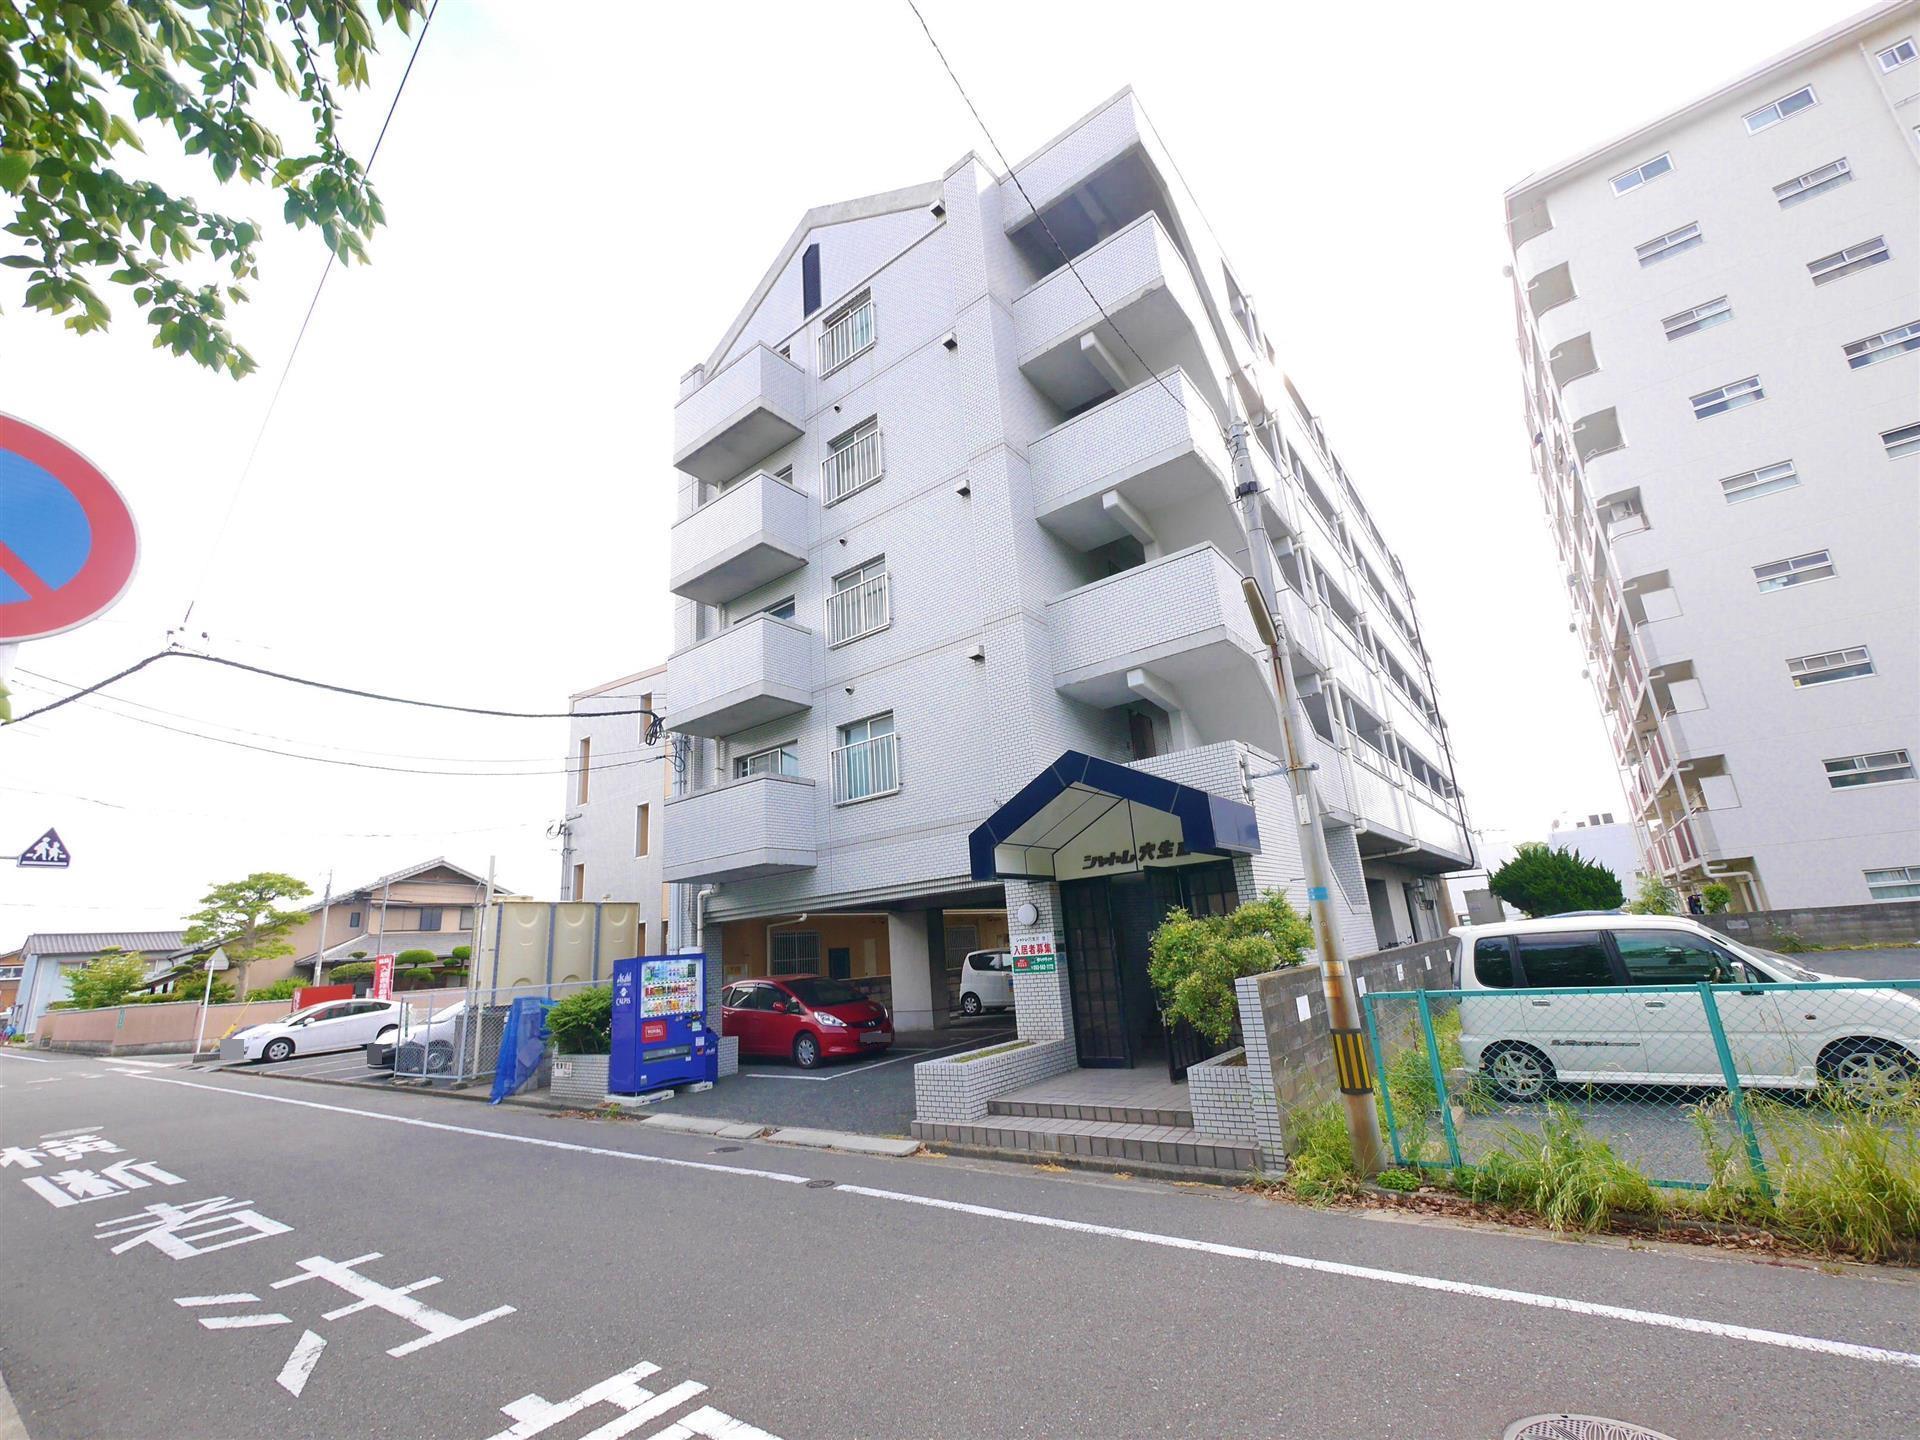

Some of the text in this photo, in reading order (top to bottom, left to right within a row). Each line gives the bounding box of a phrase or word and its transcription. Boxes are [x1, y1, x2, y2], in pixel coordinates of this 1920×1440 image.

[1014, 944, 1052, 955] 入居者募集
[617, 972, 631, 983] Asahi
[616, 997, 631, 1006] CALPIS
